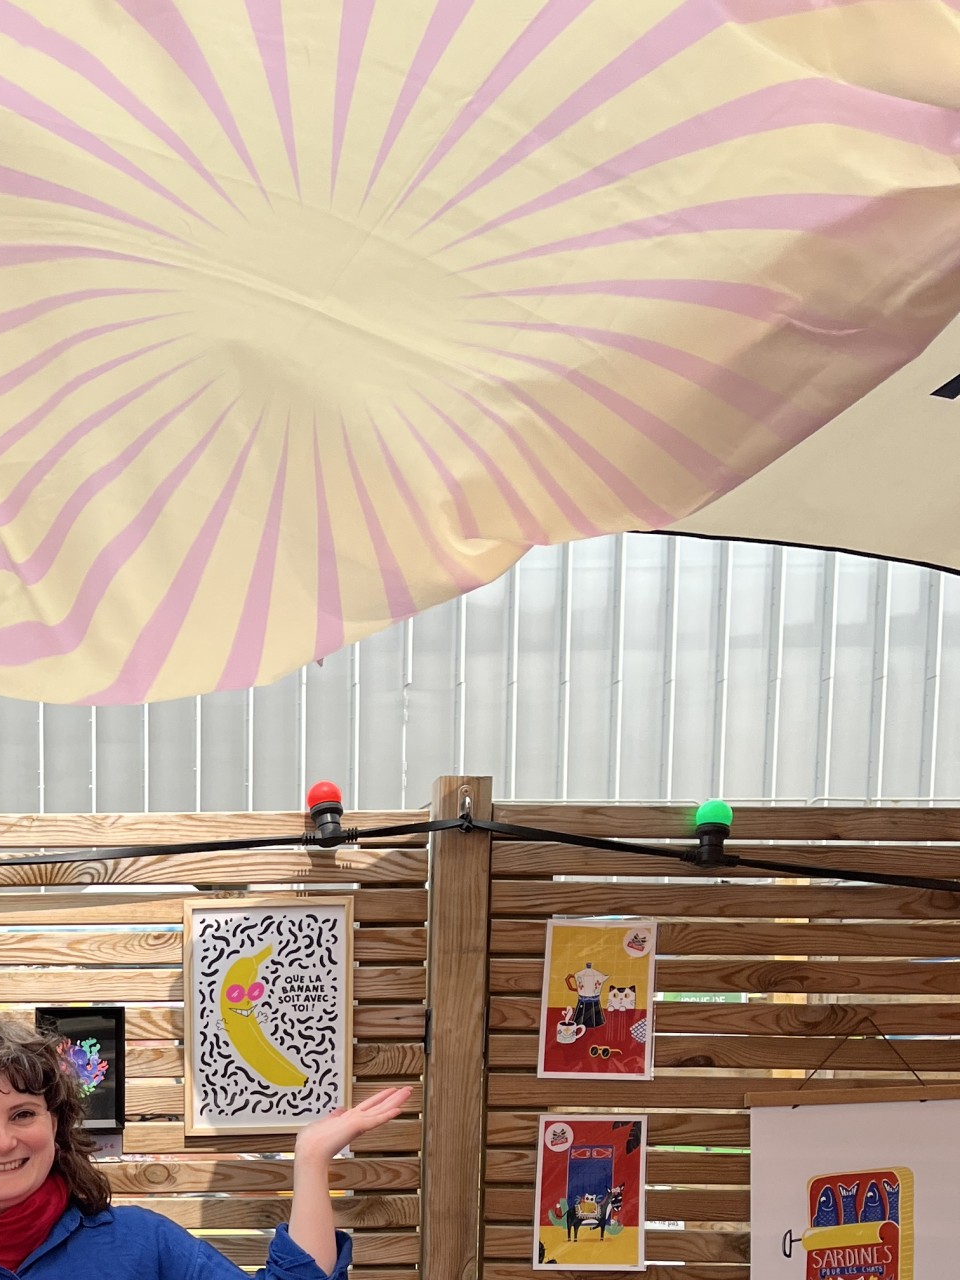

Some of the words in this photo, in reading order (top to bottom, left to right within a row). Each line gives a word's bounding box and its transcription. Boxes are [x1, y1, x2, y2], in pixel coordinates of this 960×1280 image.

[284, 974, 305, 984] QUE
[309, 975, 322, 983] LA
[281, 984, 325, 994] BANANE
[278, 994, 301, 1004] SOIT
[303, 994, 329, 1002] AVEC
[291, 1004, 309, 1012] TOI
[812, 1245, 892, 1268] SARDINES
[821, 1268, 841, 1276] POUR
[861, 1265, 883, 1273] CHATS
